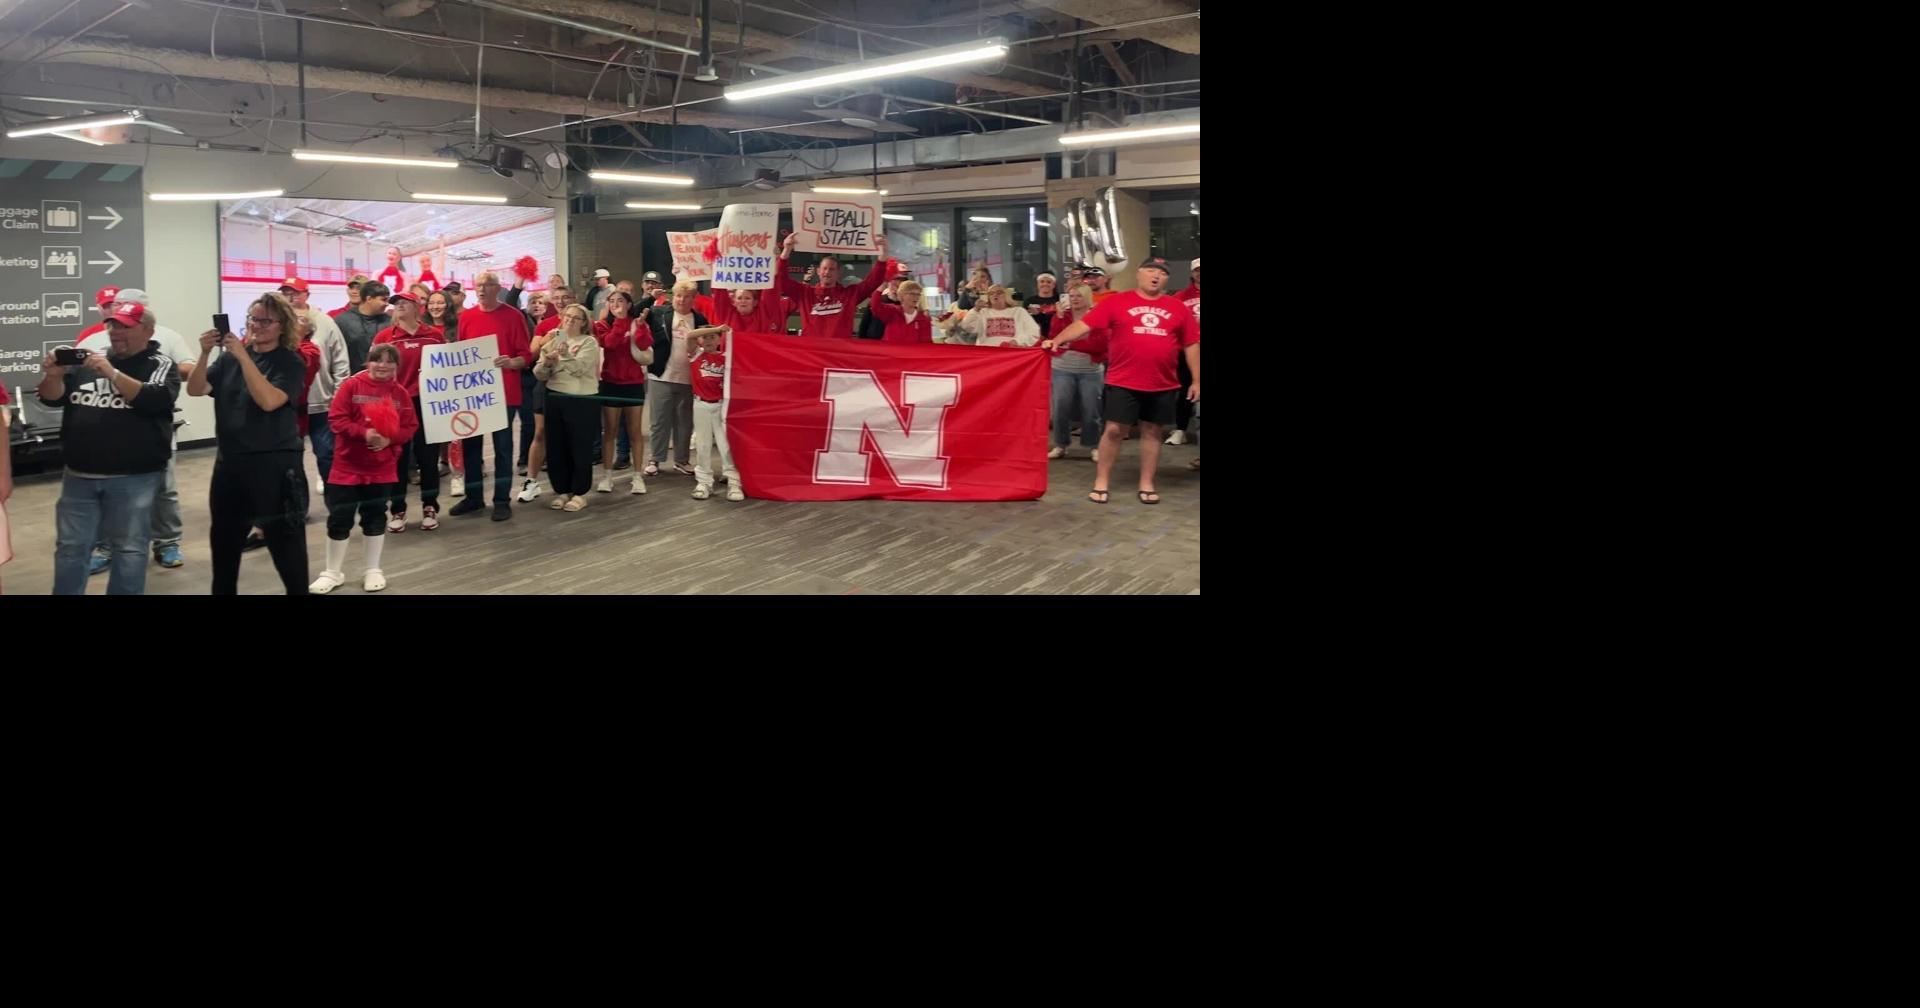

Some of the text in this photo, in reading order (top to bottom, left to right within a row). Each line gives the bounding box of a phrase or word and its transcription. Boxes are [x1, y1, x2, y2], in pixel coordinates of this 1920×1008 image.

[2, 219, 39, 229] Claim
[820, 229, 868, 246] STATE
[716, 256, 772, 269] HISTORY
[715, 271, 770, 284] MAKERS
[0, 299, 40, 310] round
[430, 347, 491, 368] MILLER
[0, 362, 40, 373] arking
[426, 369, 495, 393] NO FORKS
[427, 392, 499, 415] THIS TIME
[812, 367, 962, 490] N
